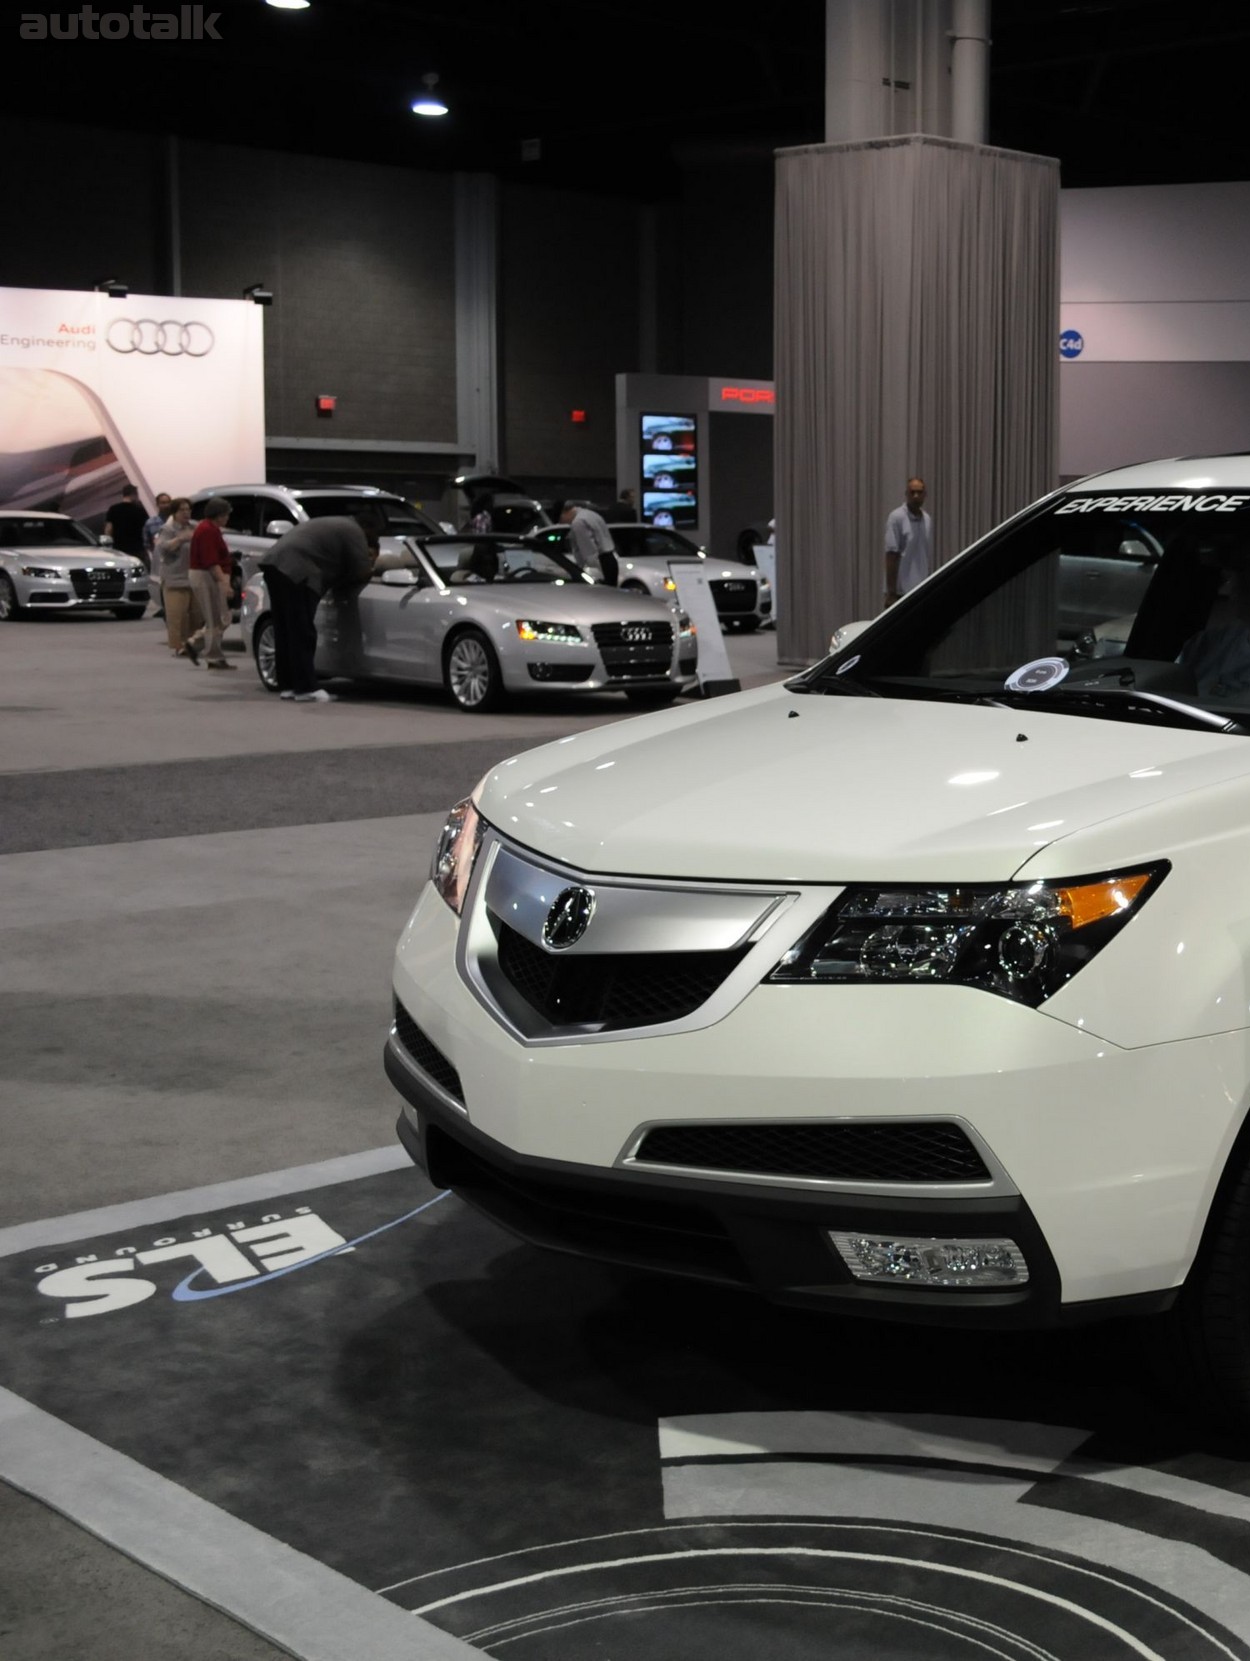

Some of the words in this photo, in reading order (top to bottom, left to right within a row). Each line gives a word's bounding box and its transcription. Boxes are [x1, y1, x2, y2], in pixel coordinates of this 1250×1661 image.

[0, 335, 96, 350] Engineering
[58, 324, 96, 335] Audi
[34, 1206, 312, 1274] SURROUND
[37, 1213, 356, 1319] ELS
